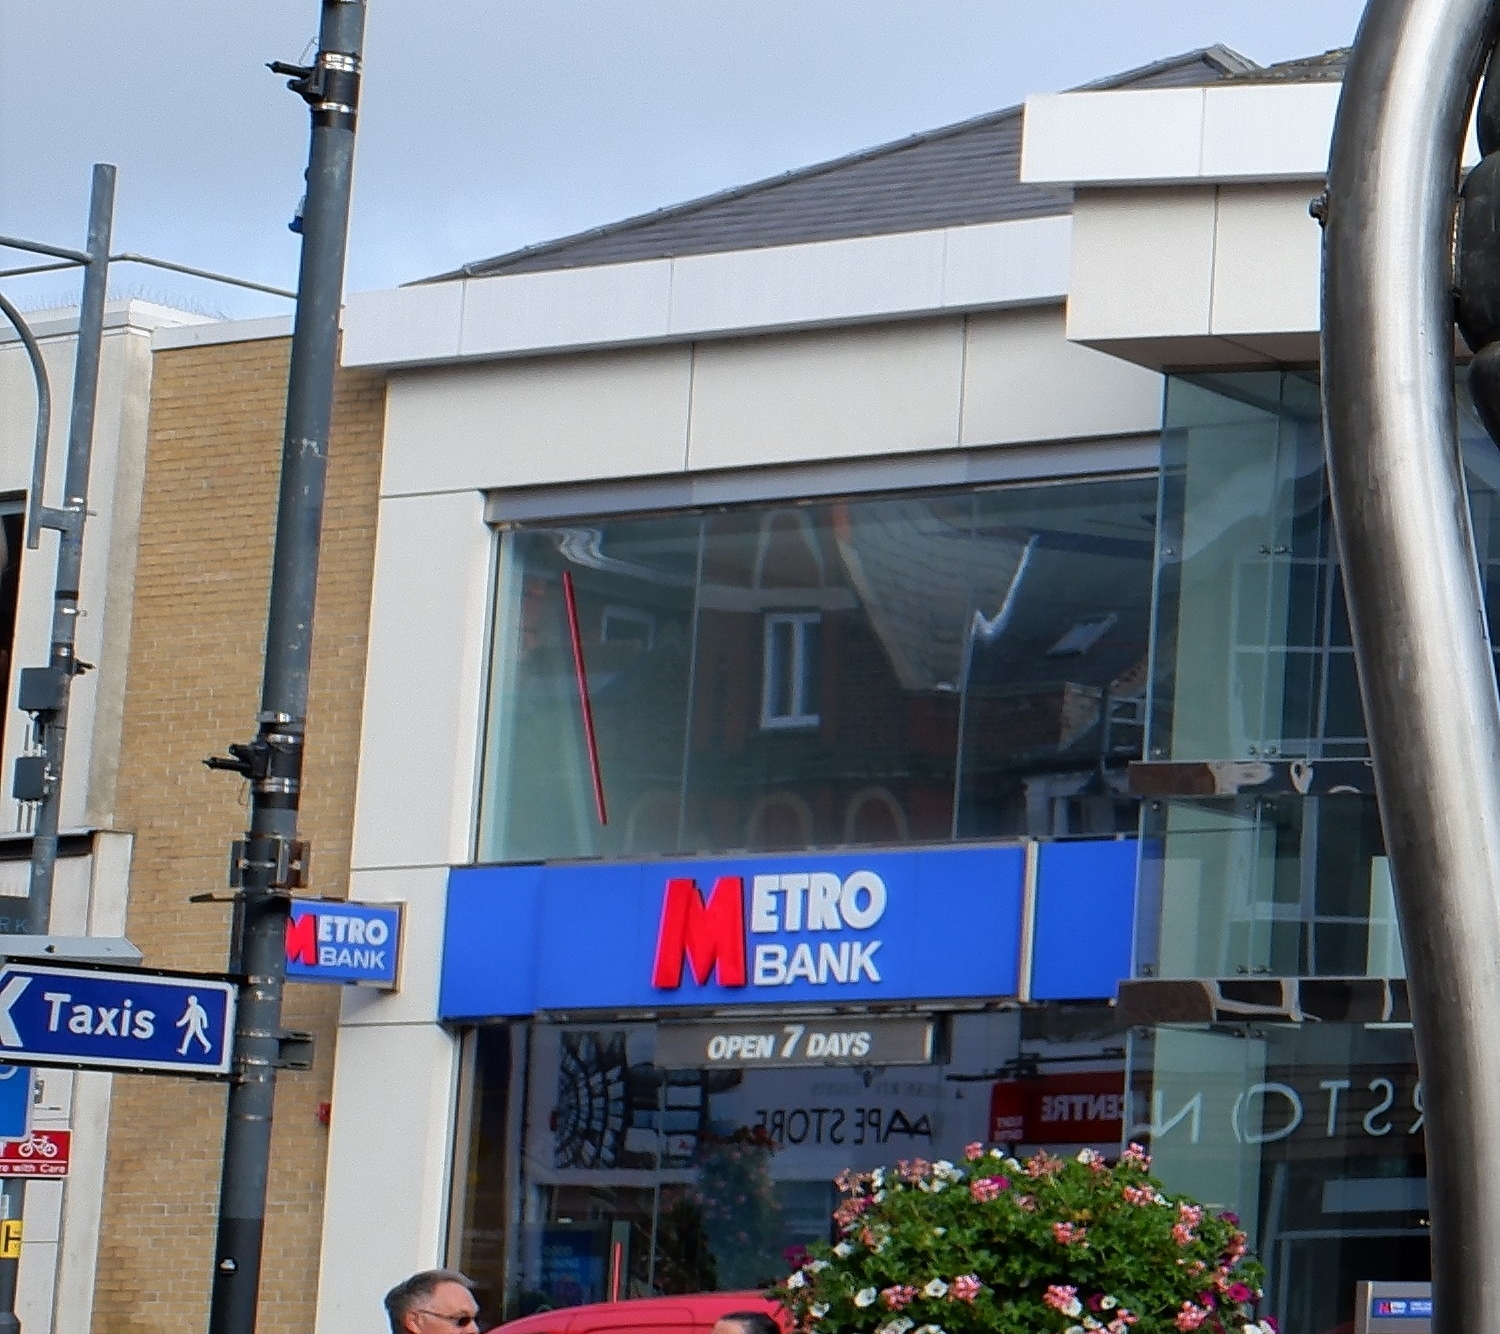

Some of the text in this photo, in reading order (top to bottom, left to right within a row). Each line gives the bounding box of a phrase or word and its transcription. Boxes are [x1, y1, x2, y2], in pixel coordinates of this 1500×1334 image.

[652, 870, 888, 989] METRO
[319, 946, 386, 971] BANK
[753, 940, 882, 987] BANK
[44, 991, 156, 1040] Taxis
[707, 1024, 873, 1061] OPEN 7 DAYS
